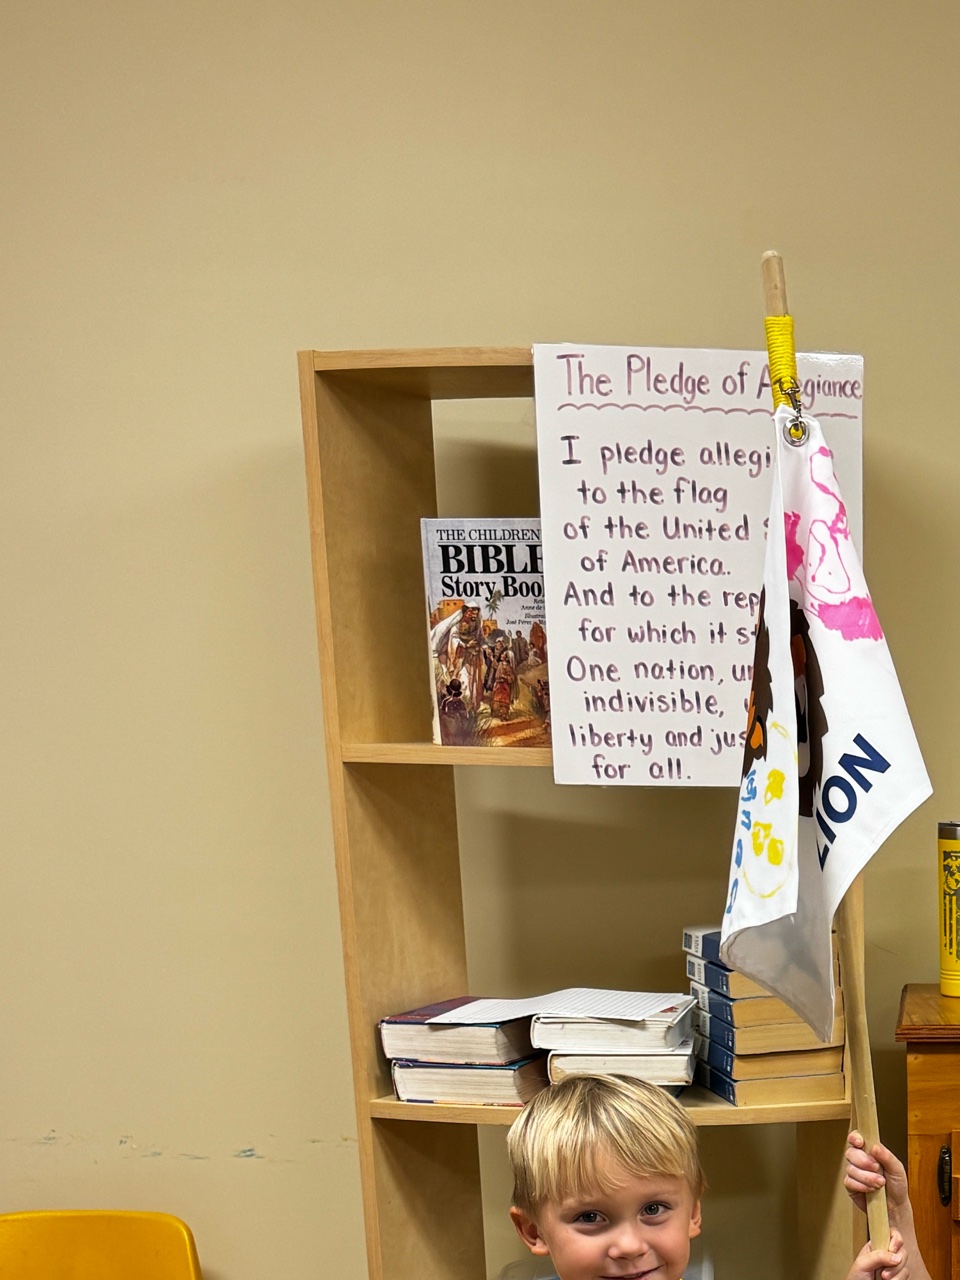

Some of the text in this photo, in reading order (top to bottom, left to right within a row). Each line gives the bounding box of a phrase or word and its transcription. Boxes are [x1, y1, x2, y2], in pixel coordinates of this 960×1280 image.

[557, 354, 862, 410] The Pledge of Agiance
[560, 435, 580, 466] I
[600, 439, 686, 476] pledge
[577, 477, 728, 513] to the flag
[436, 529, 466, 541] THE
[563, 515, 590, 540] of
[604, 515, 650, 540] the
[662, 515, 750, 541] United
[580, 554, 607, 573] of
[441, 575, 545, 602] Story Boo
[563, 582, 614, 607] And
[628, 585, 654, 606] to
[668, 583, 711, 607] the
[578, 618, 616, 643] for
[627, 621, 696, 645] which
[710, 621, 727, 644] it
[567, 656, 621, 682] One
[634, 659, 724, 686] nation,
[584, 690, 725, 719] indivisible,
[569, 724, 653, 754] liberty
[665, 725, 702, 748] and
[592, 758, 691, 780] for all.
